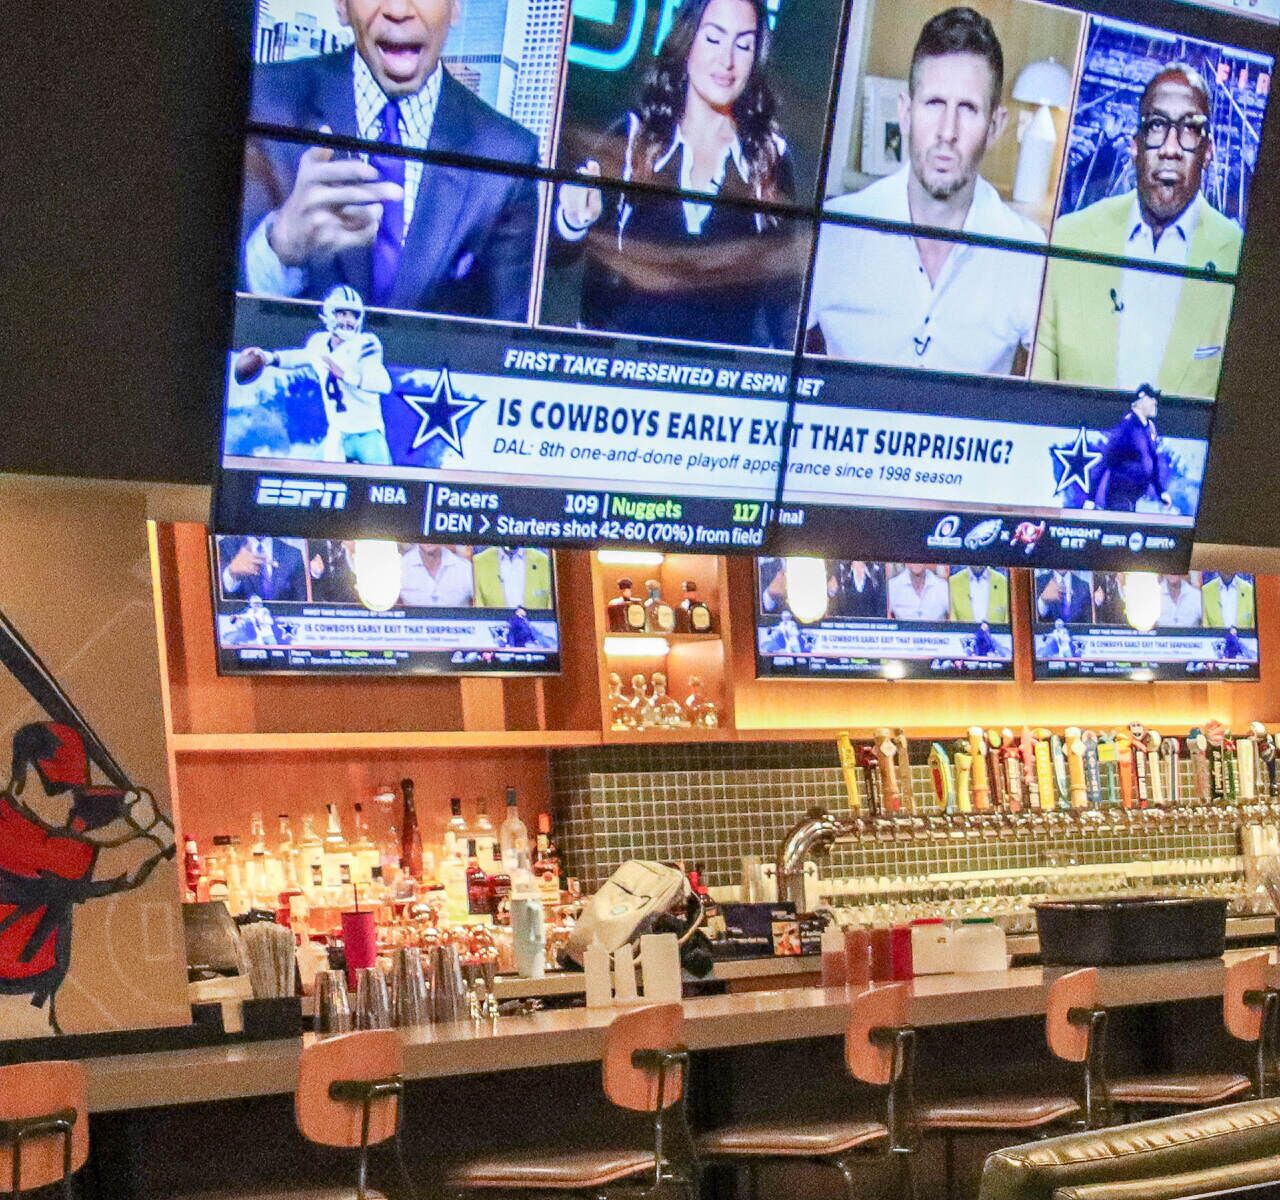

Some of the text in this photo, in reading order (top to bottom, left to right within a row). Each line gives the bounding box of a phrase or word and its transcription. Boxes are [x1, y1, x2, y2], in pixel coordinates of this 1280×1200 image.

[504, 349, 560, 372] FIRST
[563, 355, 609, 377] TAKE
[610, 360, 714, 386] PRESENTED
[716, 370, 741, 389] BY
[741, 372, 788, 393] ESPN
[497, 398, 522, 427] IS
[530, 401, 660, 437] COWBOYS
[666, 412, 743, 443] EARLY
[810, 423, 869, 453] THAT
[873, 429, 1014, 465] SURPRISING?
[493, 438, 962, 485] DAL: 8th one-and-done playoff apperance since 1998 season
[256, 478, 804, 525] ESPN NBA Pacers 109 Nuggets 117 inal
[435, 513, 763, 545] DEN Starters shot 42-60 (70%) from field
[1049, 526, 1101, 539] TONIGHT
